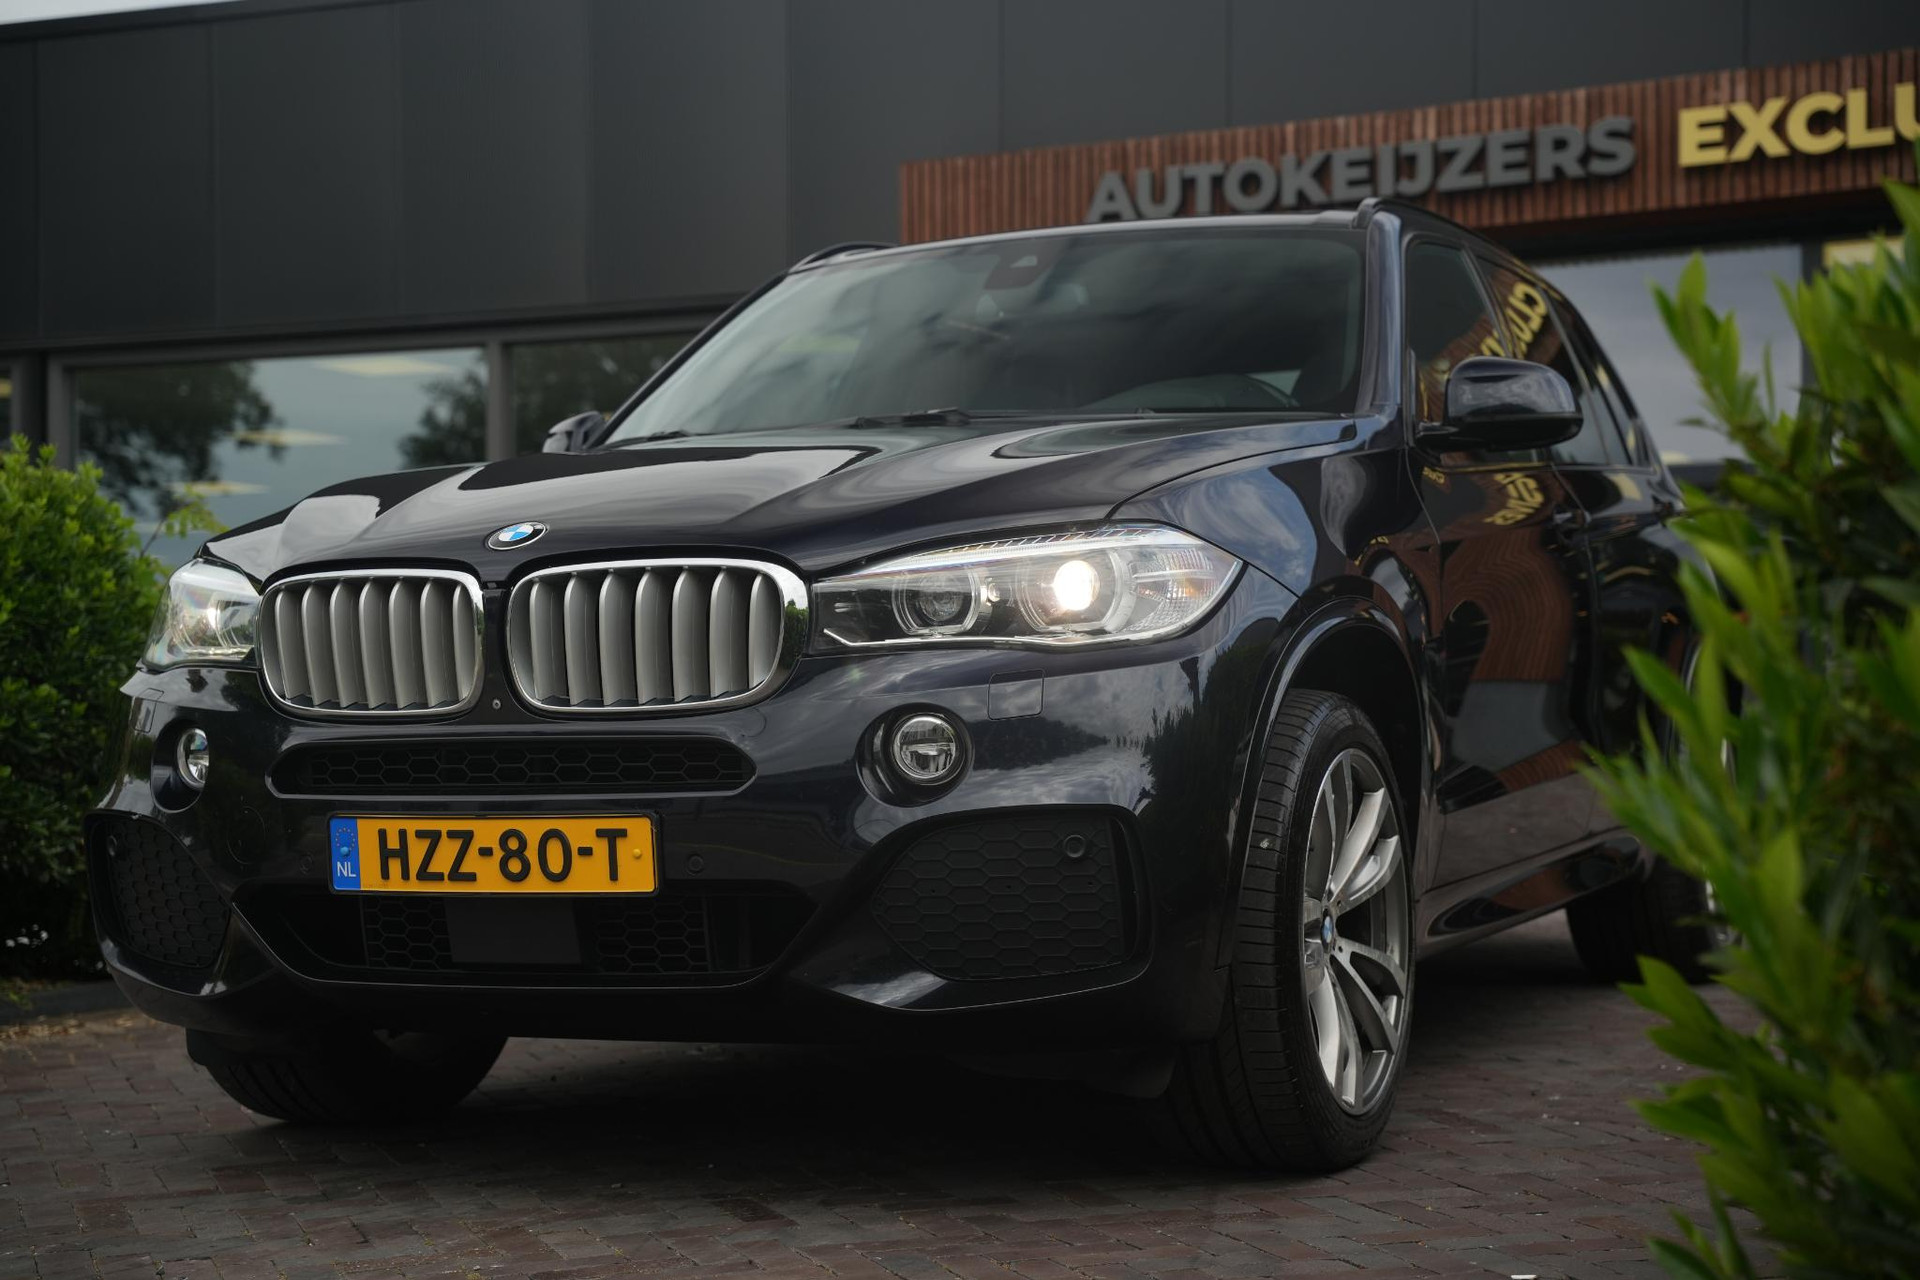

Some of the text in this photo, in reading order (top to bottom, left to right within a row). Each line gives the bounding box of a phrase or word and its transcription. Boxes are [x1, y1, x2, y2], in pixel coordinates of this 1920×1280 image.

[1085, 116, 1637, 223] AUTOKEIJZERS
[337, 861, 357, 877] NL
[378, 828, 628, 882] HZZ-80-T
